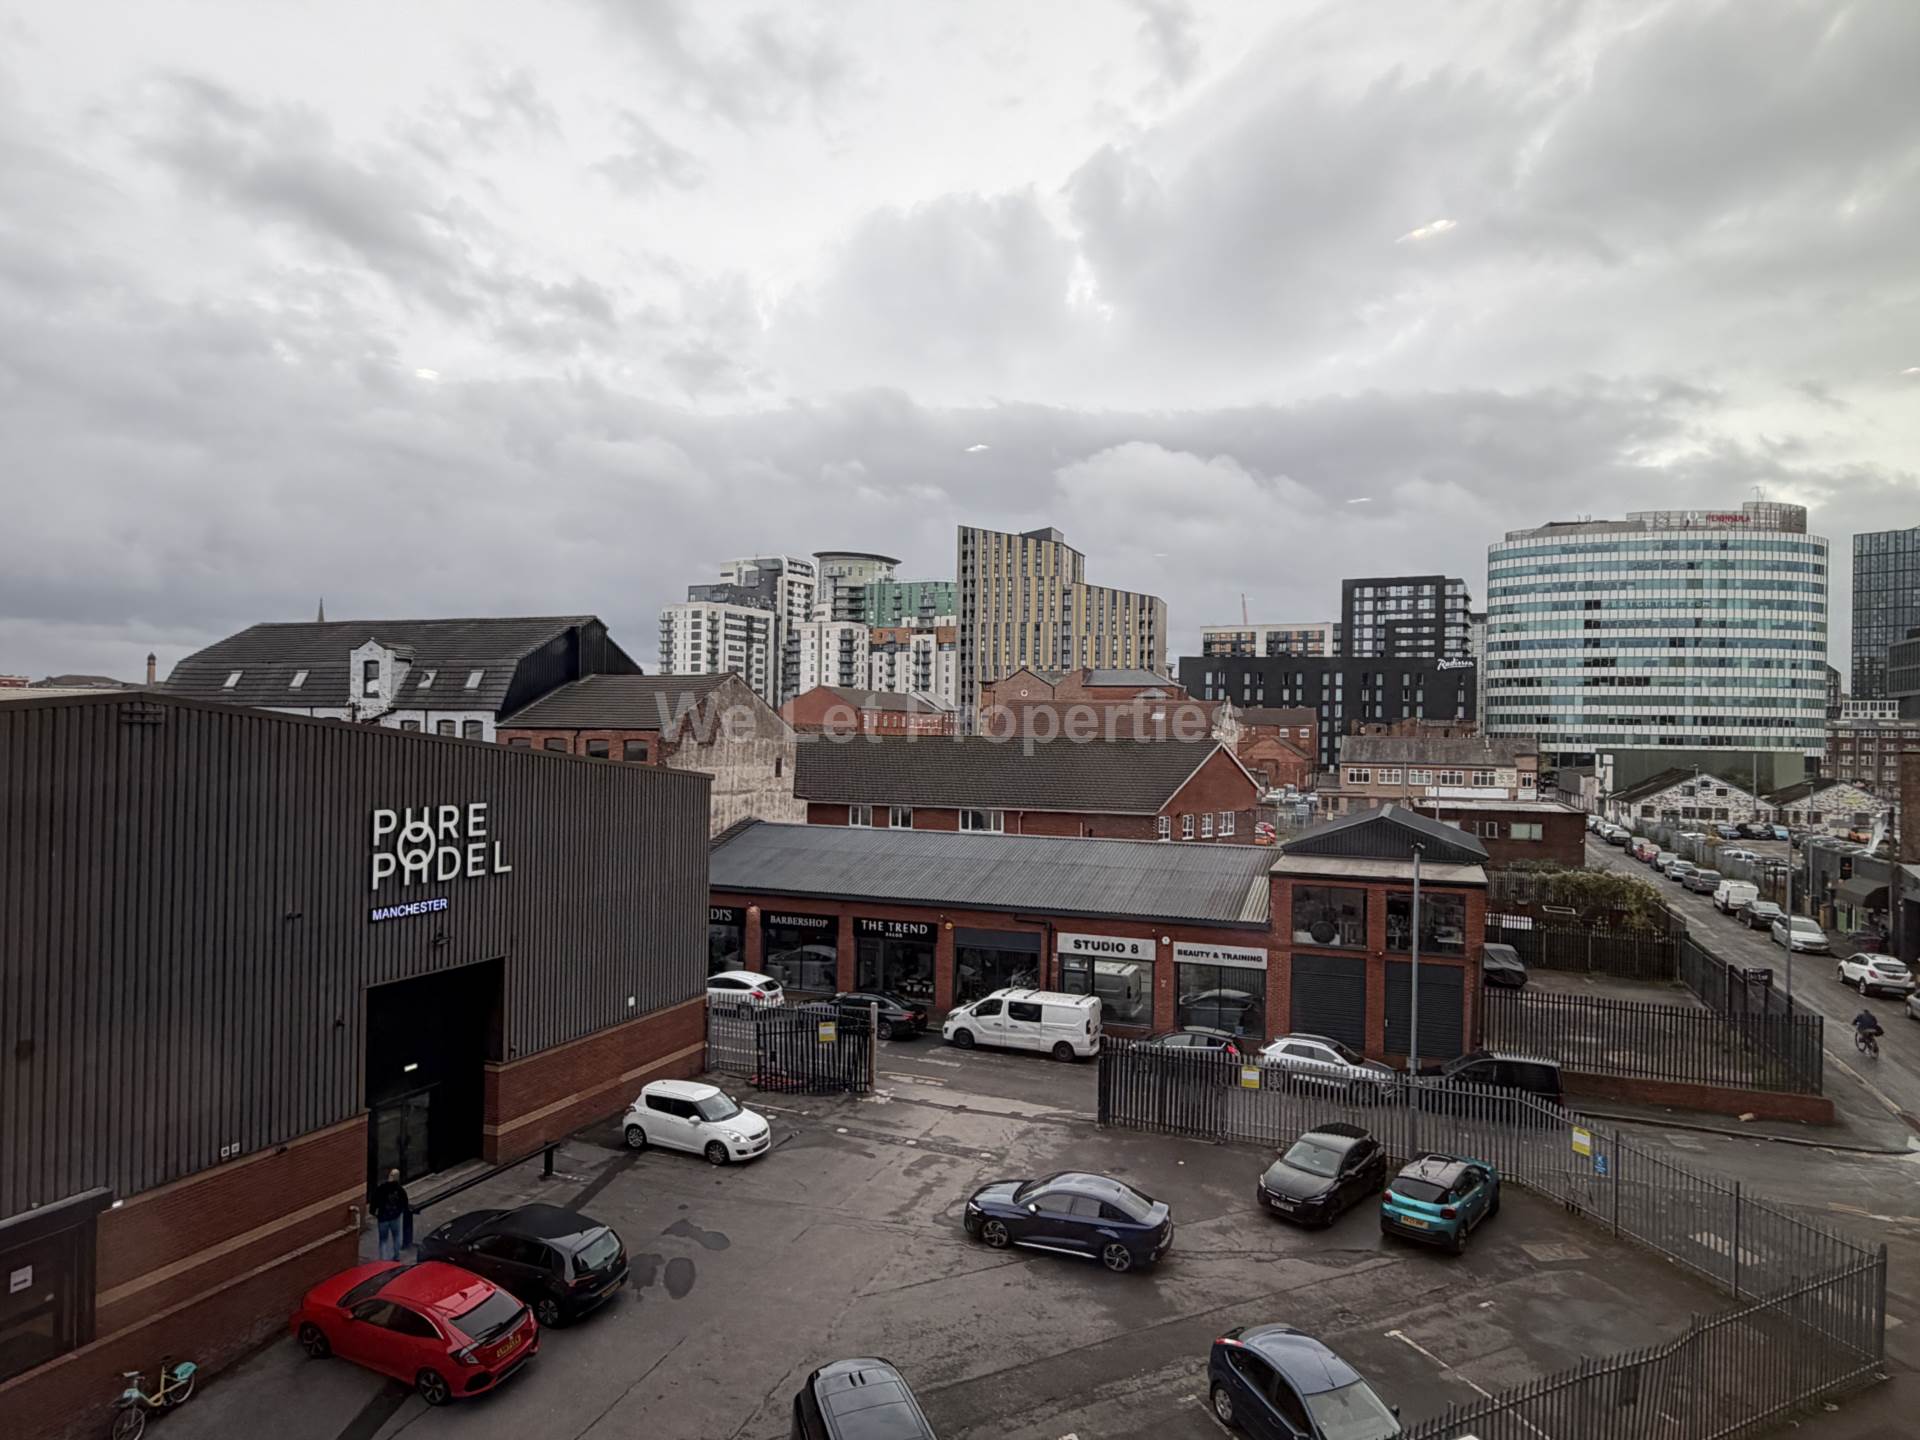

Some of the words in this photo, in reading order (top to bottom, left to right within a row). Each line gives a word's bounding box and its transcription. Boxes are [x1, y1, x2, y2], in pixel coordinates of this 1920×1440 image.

[373, 802, 487, 846] PURE
[372, 841, 512, 890] PADEL
[372, 899, 447, 920] MANCHESTER
[770, 914, 829, 929] BARBERSHOP
[861, 919, 884, 932] THE
[888, 921, 928, 935] TREND
[1073, 939, 1127, 953] STUDIO
[1130, 943, 1139, 955] 8
[1177, 948, 1211, 959] BEAUTY
[1212, 952, 1220, 961] &
[1221, 952, 1263, 963] TRAINING
